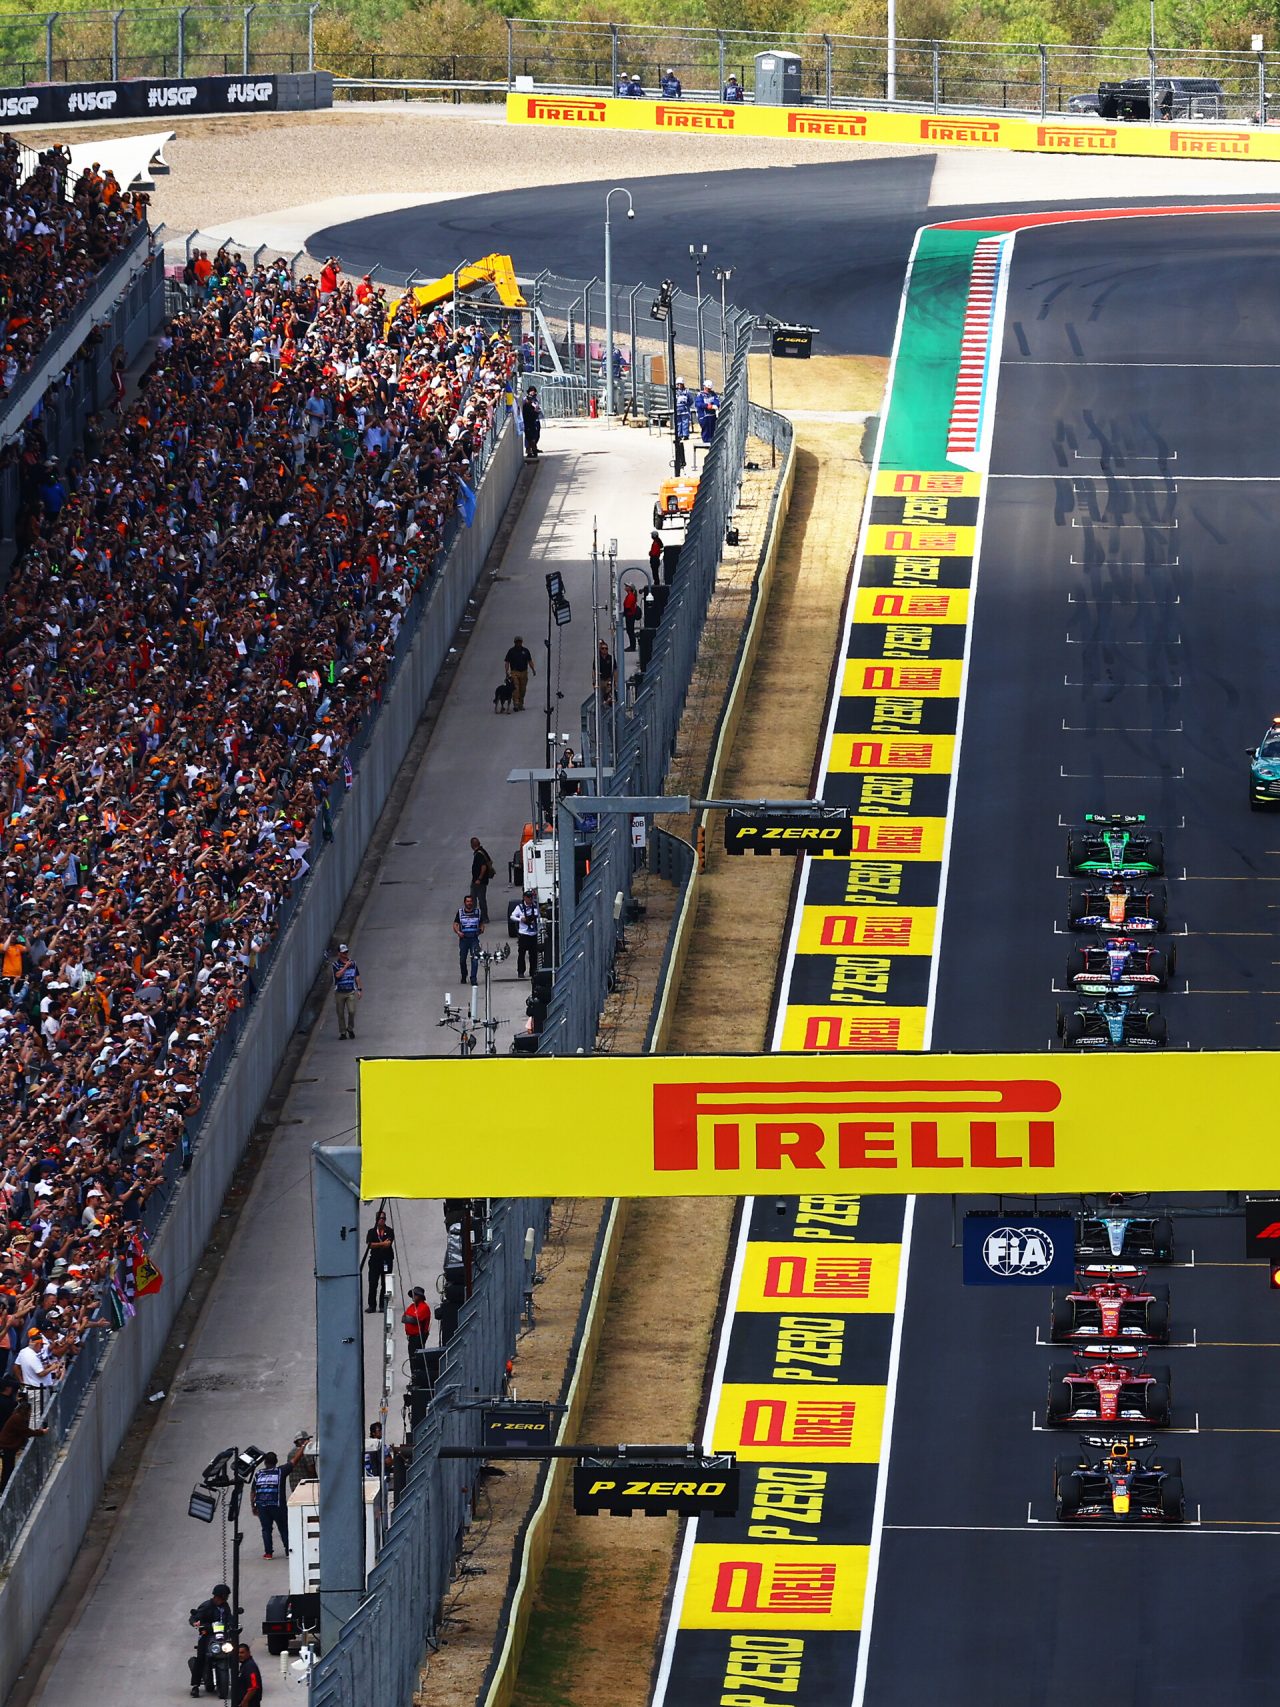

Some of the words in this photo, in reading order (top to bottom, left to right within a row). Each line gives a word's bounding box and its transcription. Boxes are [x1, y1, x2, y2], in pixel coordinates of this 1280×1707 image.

[68, 91, 117, 112] #USGP
[148, 87, 197, 107] #USGP
[227, 83, 273, 103] #USGP
[527, 99, 606, 122] PIRELLI
[656, 106, 735, 129] PIRELLI
[788, 113, 867, 136] PIRELLI
[920, 120, 1000, 142] PIRELLI
[1037, 127, 1117, 149] PIRELLI
[1170, 132, 1250, 154] PIRELLI
[736, 827, 757, 839] P
[761, 827, 842, 839] ZERO
[820, 915, 913, 946] PIRELLI
[832, 957, 891, 993] ZERO
[830, 994, 886, 1004] P
[652, 1079, 1063, 1172] PIRELLI
[763, 1256, 872, 1298] PIRELLI
[776, 1316, 845, 1366] ZERO
[773, 1367, 839, 1382] P
[739, 1400, 856, 1447] PIRELLI
[589, 1481, 616, 1495] P
[622, 1481, 727, 1496] ZERO
[751, 1467, 827, 1523] ZERO
[748, 1525, 818, 1541] P
[712, 1561, 836, 1614] PIRELLI
[724, 1635, 805, 1692] ZERO
[720, 1694, 796, 1707] P
